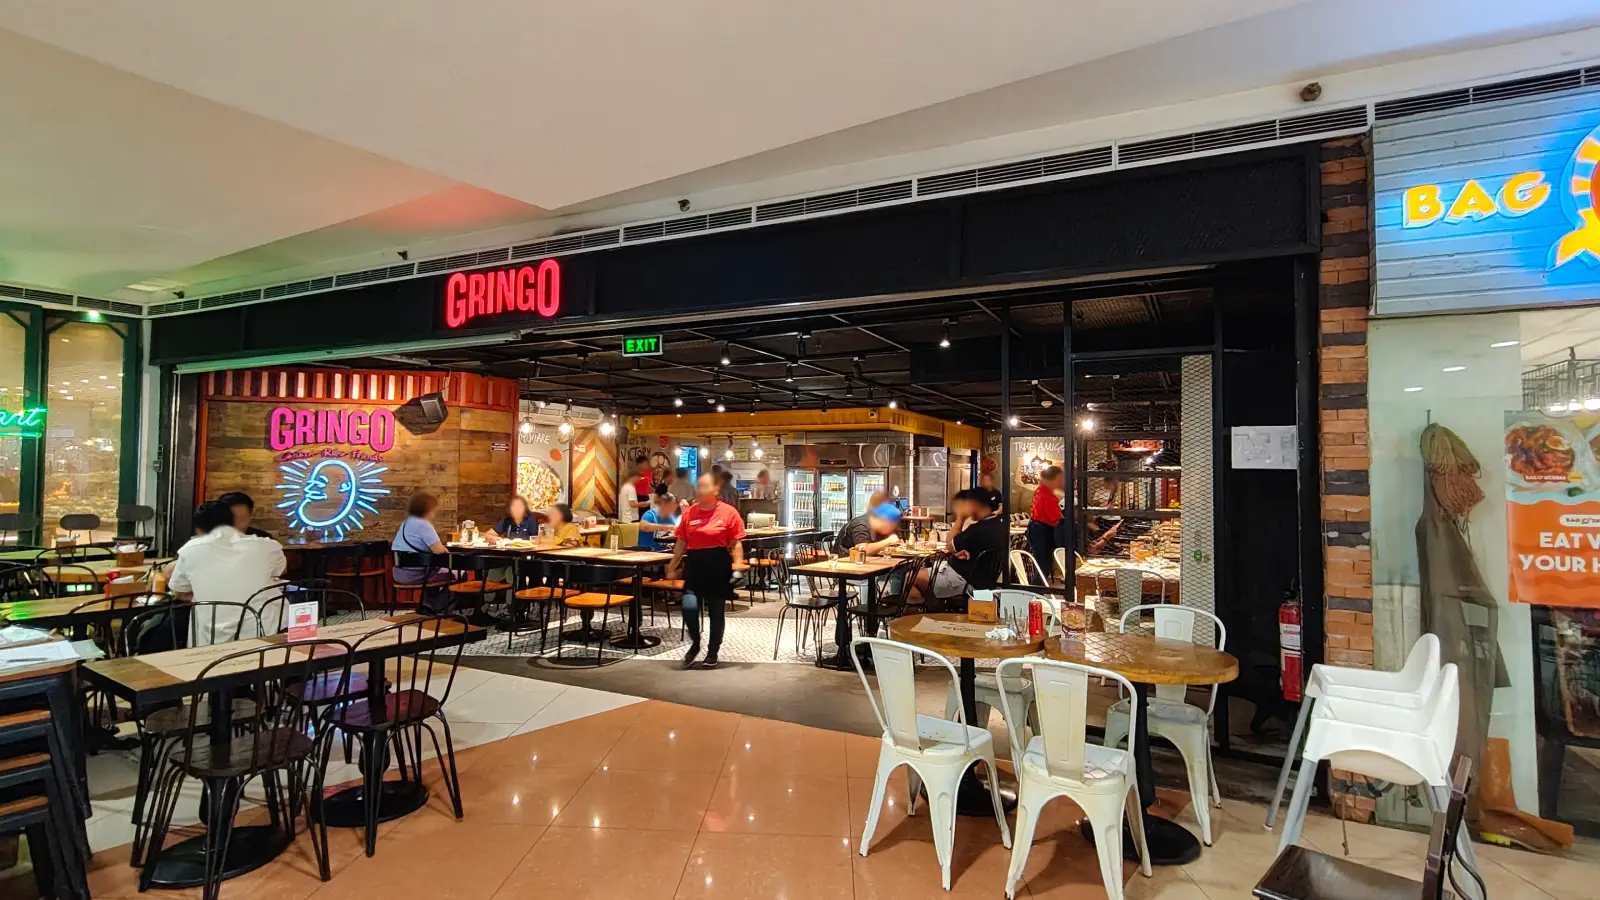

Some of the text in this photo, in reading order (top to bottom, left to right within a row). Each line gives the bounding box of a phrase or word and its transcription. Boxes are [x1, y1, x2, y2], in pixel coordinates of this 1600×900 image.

[1403, 170, 1551, 228] BAG
[446, 258, 560, 328] GRINGO
[626, 338, 657, 353] EXIT
[270, 406, 395, 453] GRINGO
[984, 441, 1064, 455] LIKE TRUE AMIGO
[1540, 532, 1583, 549] EAT
[1519, 554, 1587, 573] YOUR
